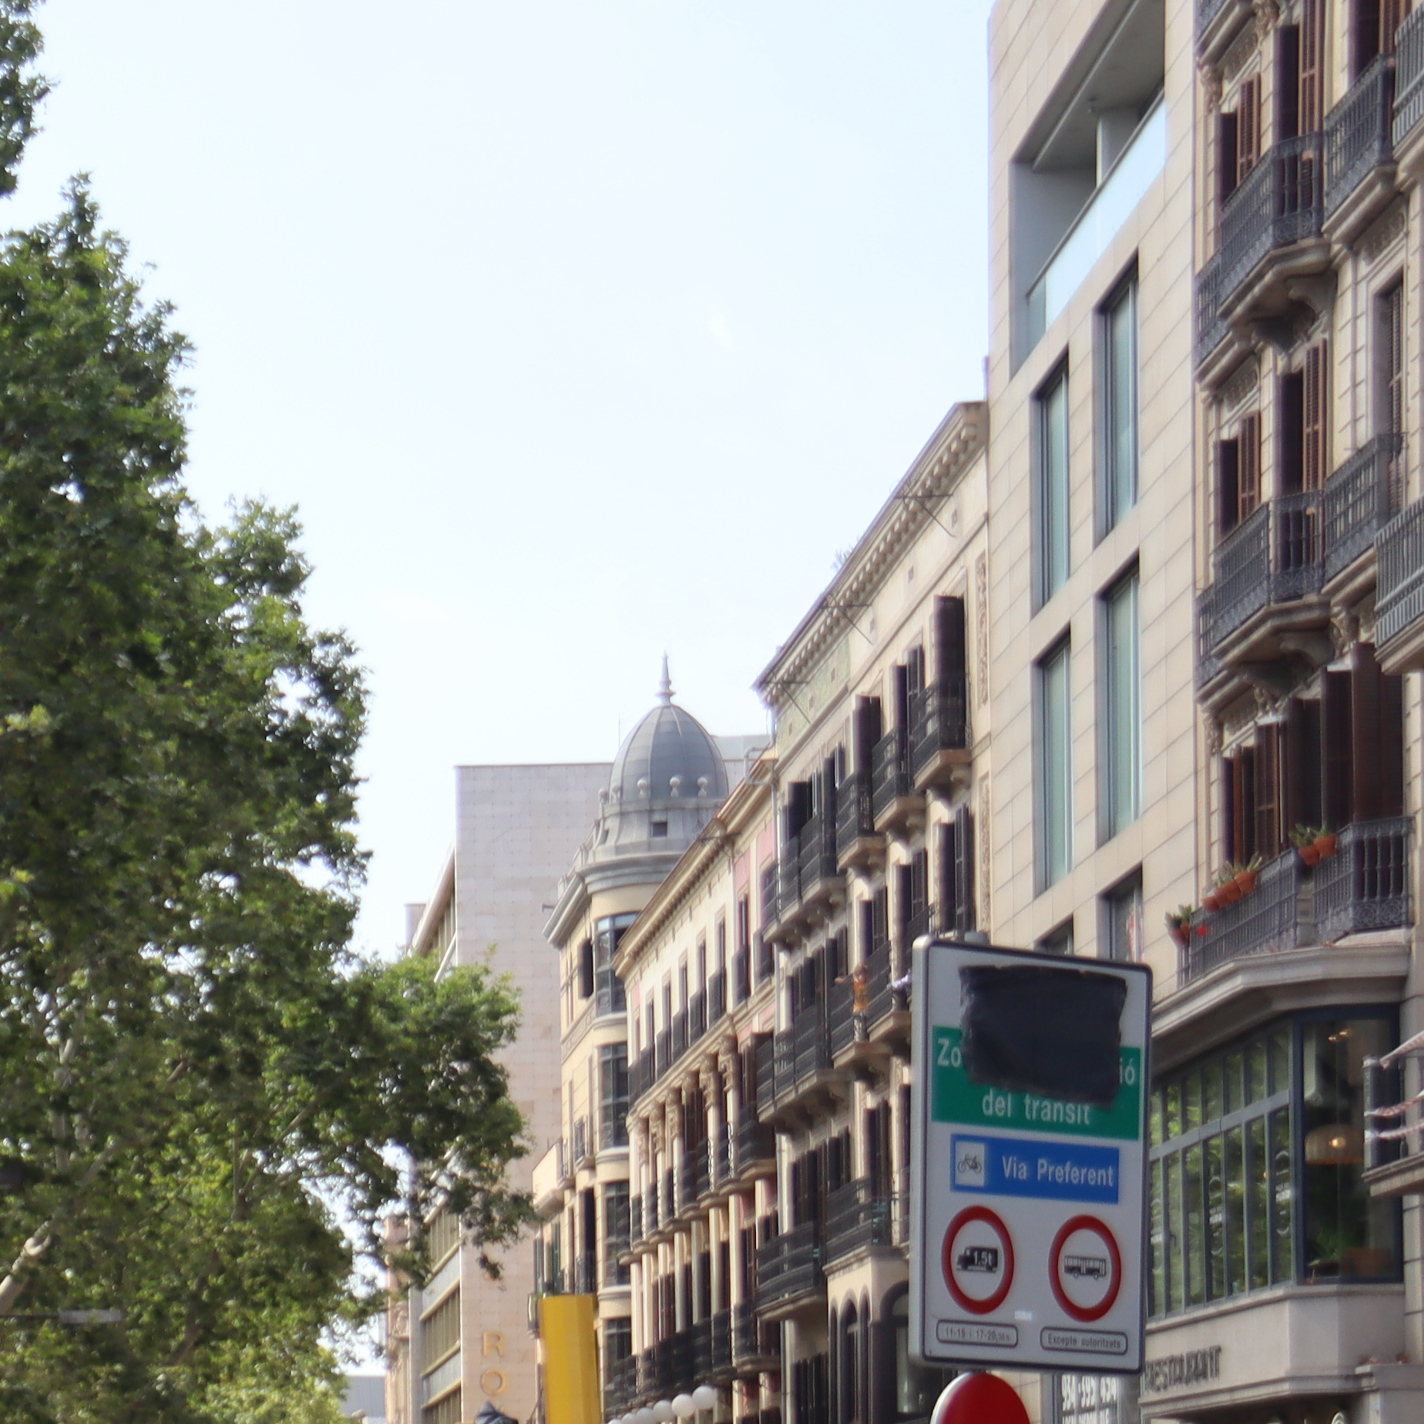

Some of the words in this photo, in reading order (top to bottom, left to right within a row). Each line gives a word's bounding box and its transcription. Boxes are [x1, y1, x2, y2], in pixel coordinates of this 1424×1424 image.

[981, 1087, 1012, 1117] del
[1002, 1156, 1027, 1180] Via
[1037, 1158, 1114, 1187] Preferent
[1047, 1333, 1078, 1347] Excepte
[1081, 1335, 1121, 1349] autoritzats
